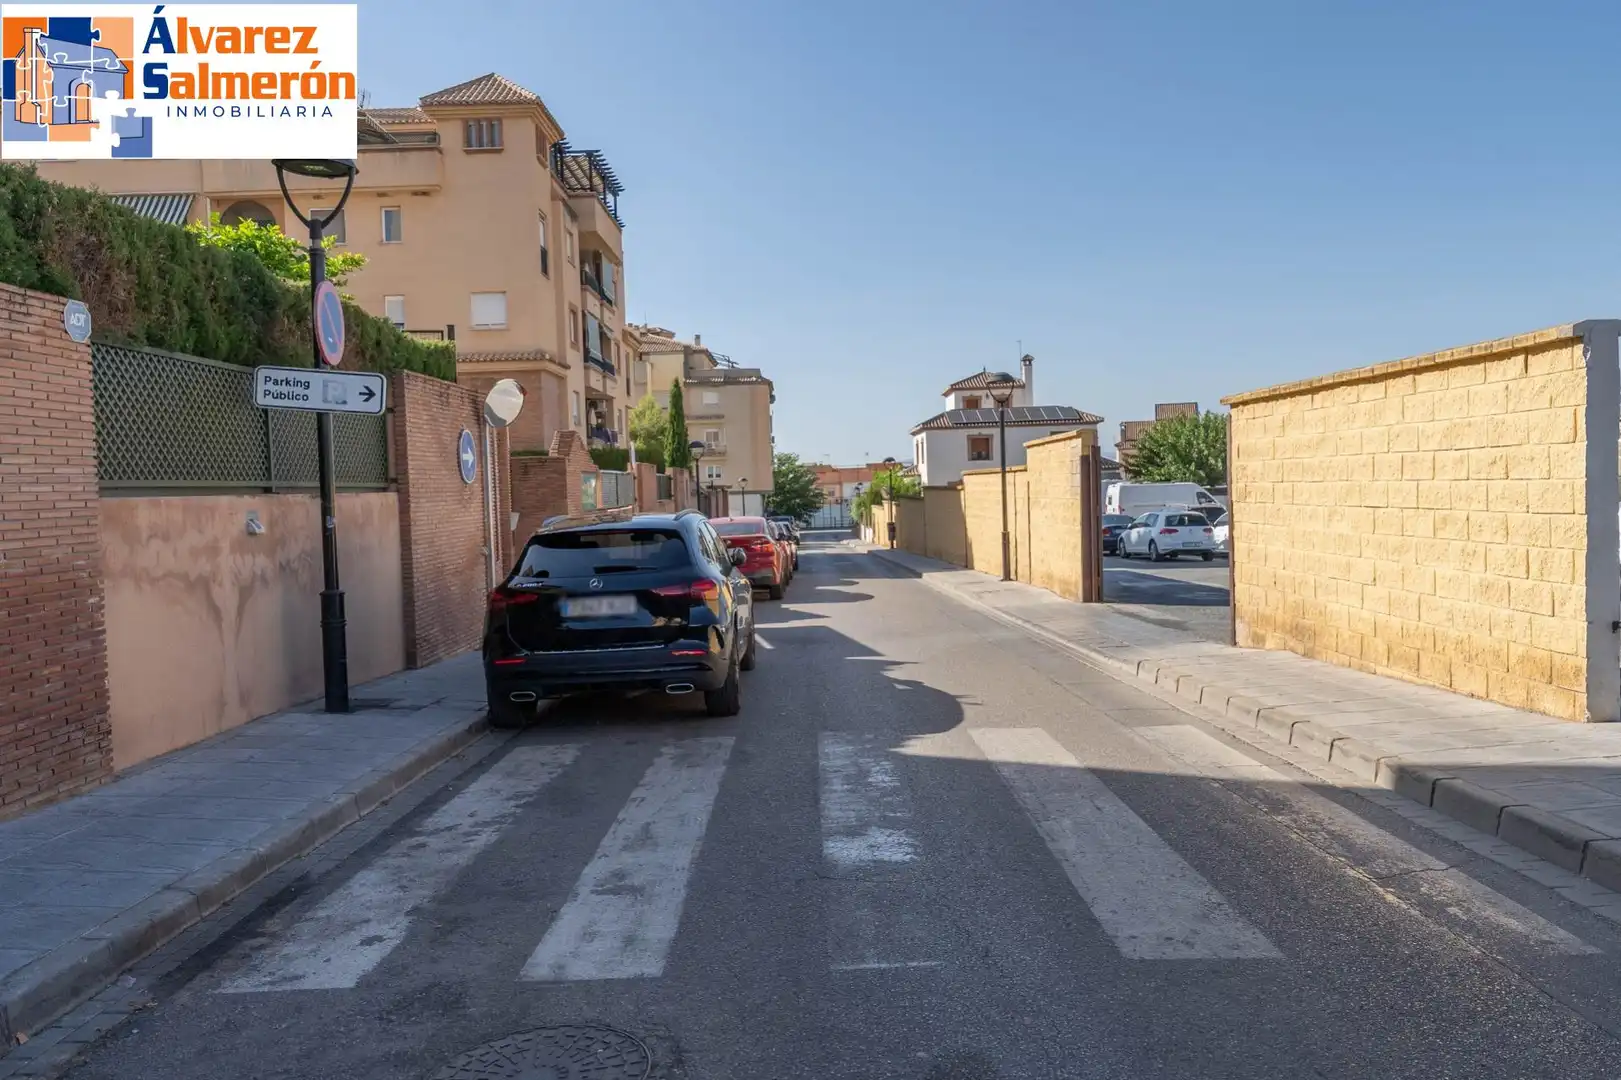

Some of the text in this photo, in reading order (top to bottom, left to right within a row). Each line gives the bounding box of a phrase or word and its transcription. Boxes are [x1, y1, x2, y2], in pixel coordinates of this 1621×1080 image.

[70, 312, 86, 327] ADT
[264, 376, 310, 390] Parking
[263, 389, 309, 402] Público
